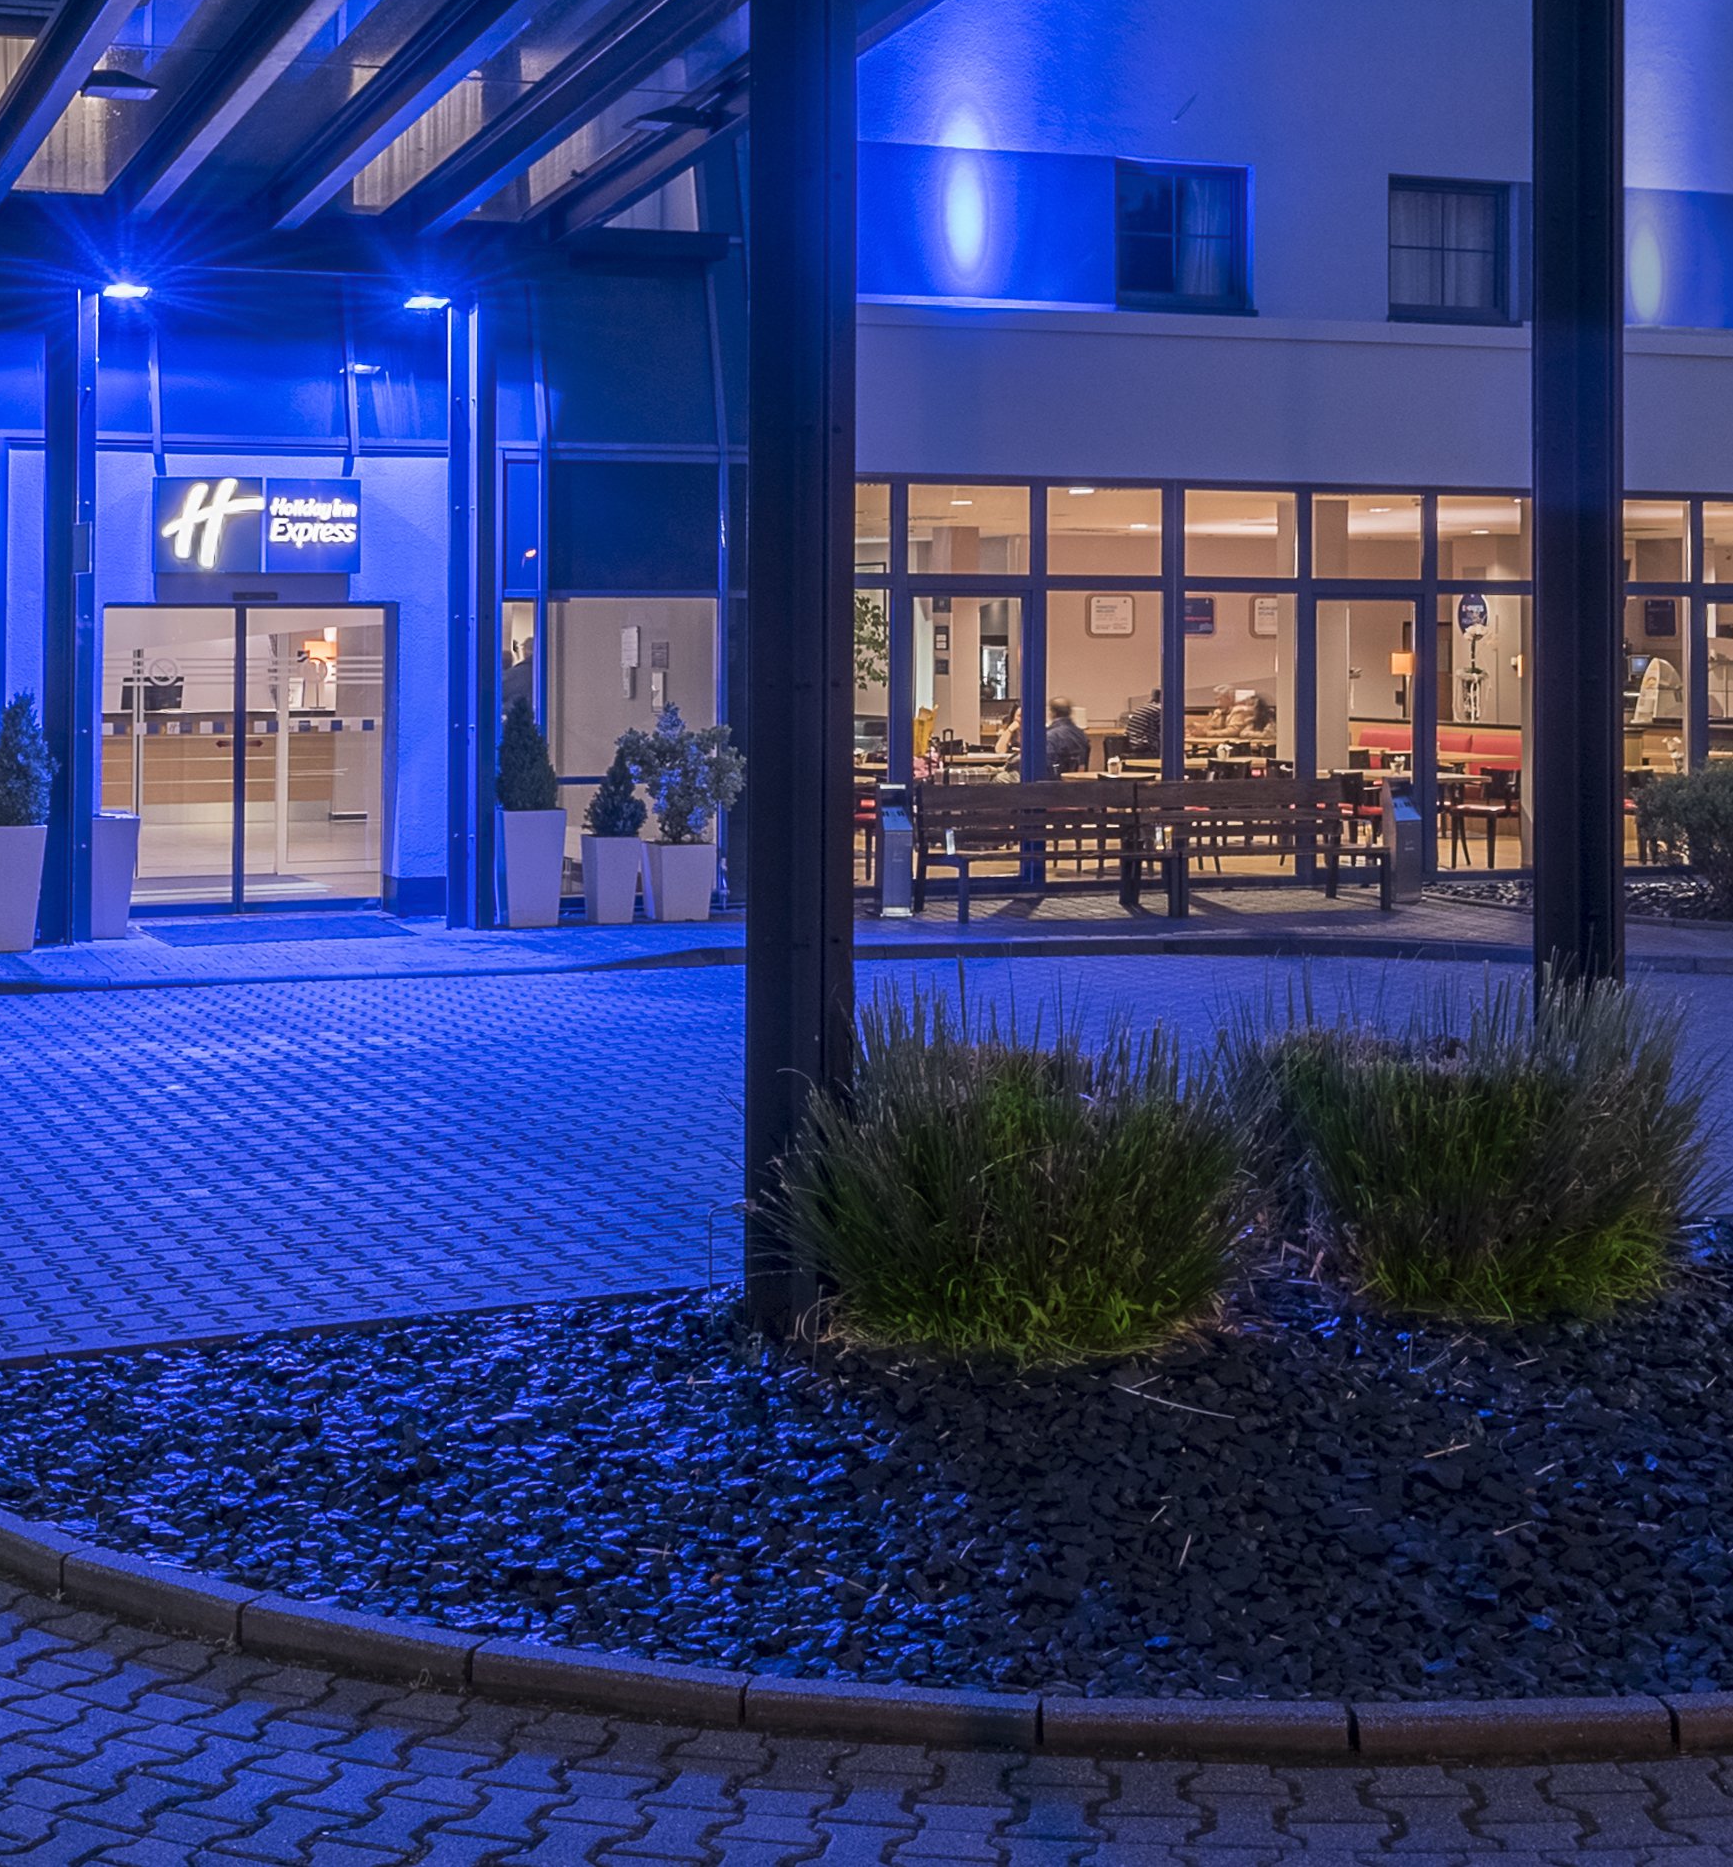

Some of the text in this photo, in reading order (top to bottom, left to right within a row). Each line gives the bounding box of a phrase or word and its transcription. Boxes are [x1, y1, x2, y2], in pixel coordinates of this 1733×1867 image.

[269, 496, 358, 521] Holiday Inn
[268, 517, 358, 549] Express
